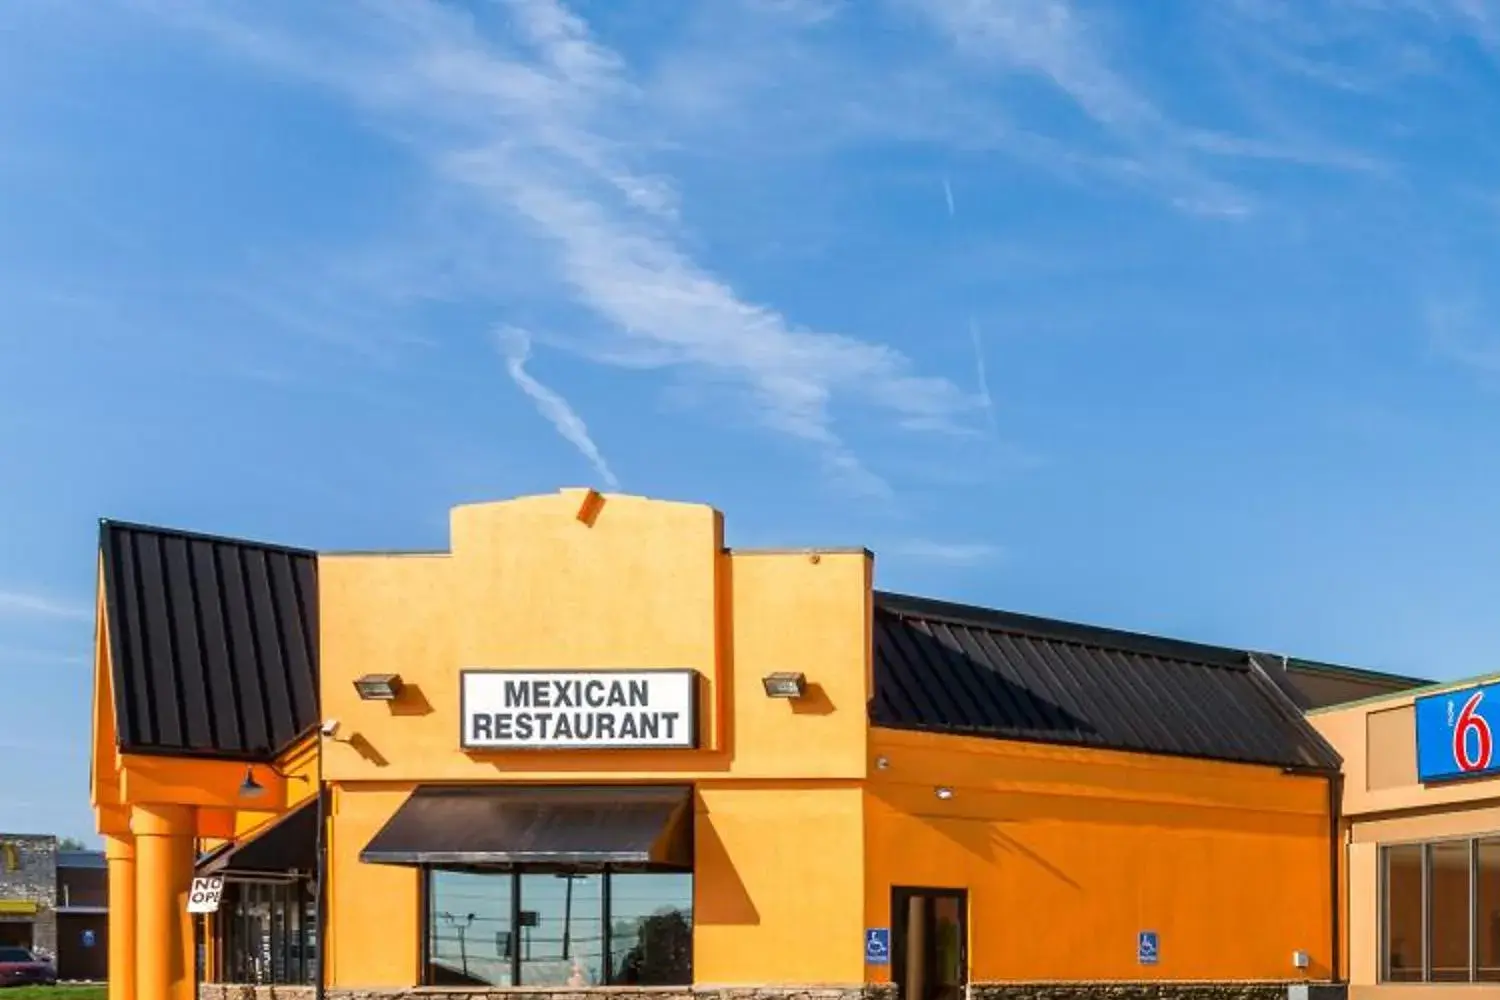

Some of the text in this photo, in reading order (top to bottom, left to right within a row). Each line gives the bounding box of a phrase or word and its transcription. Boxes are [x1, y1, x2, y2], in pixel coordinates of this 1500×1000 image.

[504, 680, 648, 708] MEXICAN
[472, 713, 678, 739] RESTAURANT
[1453, 691, 1492, 772] 6
